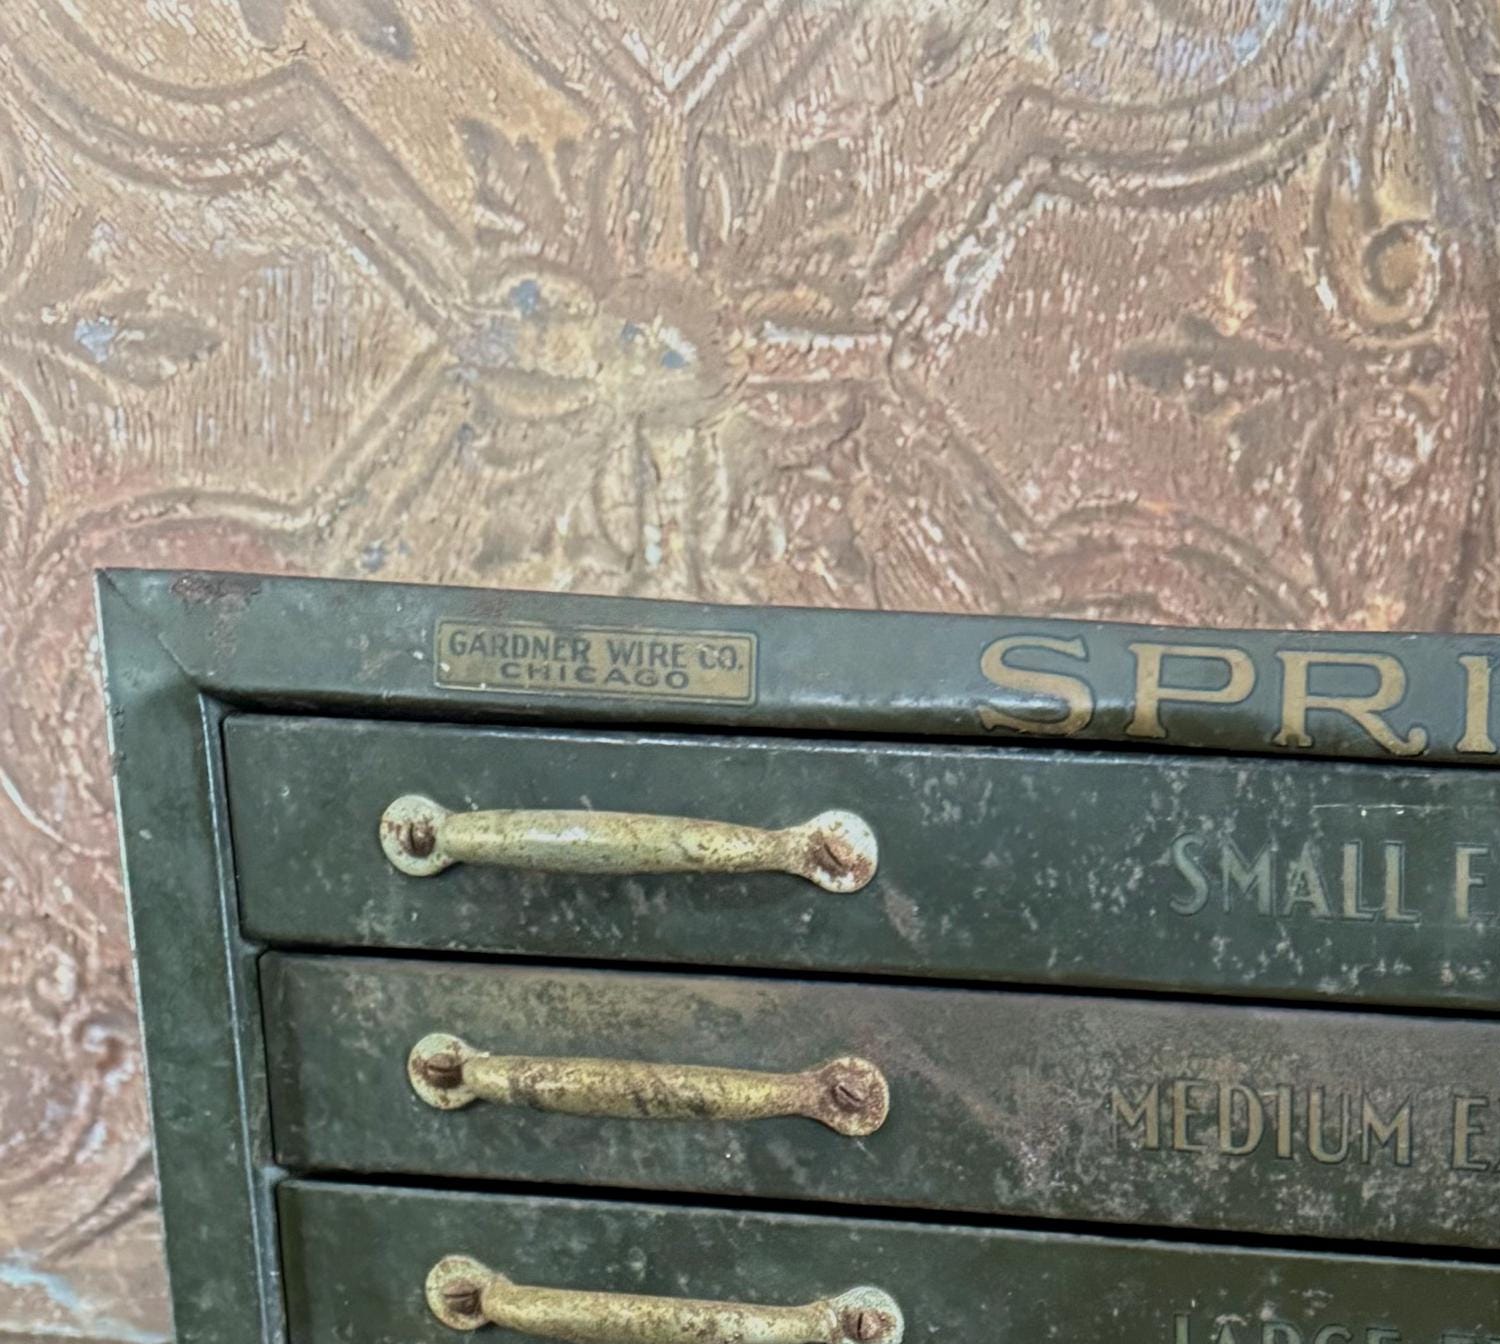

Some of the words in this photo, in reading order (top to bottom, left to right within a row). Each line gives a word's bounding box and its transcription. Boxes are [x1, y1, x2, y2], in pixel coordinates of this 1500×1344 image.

[450, 629, 592, 664] GARDNER
[606, 640, 689, 669] WIRE
[699, 644, 745, 672] CO.
[500, 662, 691, 691] CHICAGO
[1168, 832, 1421, 925] SMALL
[1110, 1078, 1414, 1168] MEDIUM
